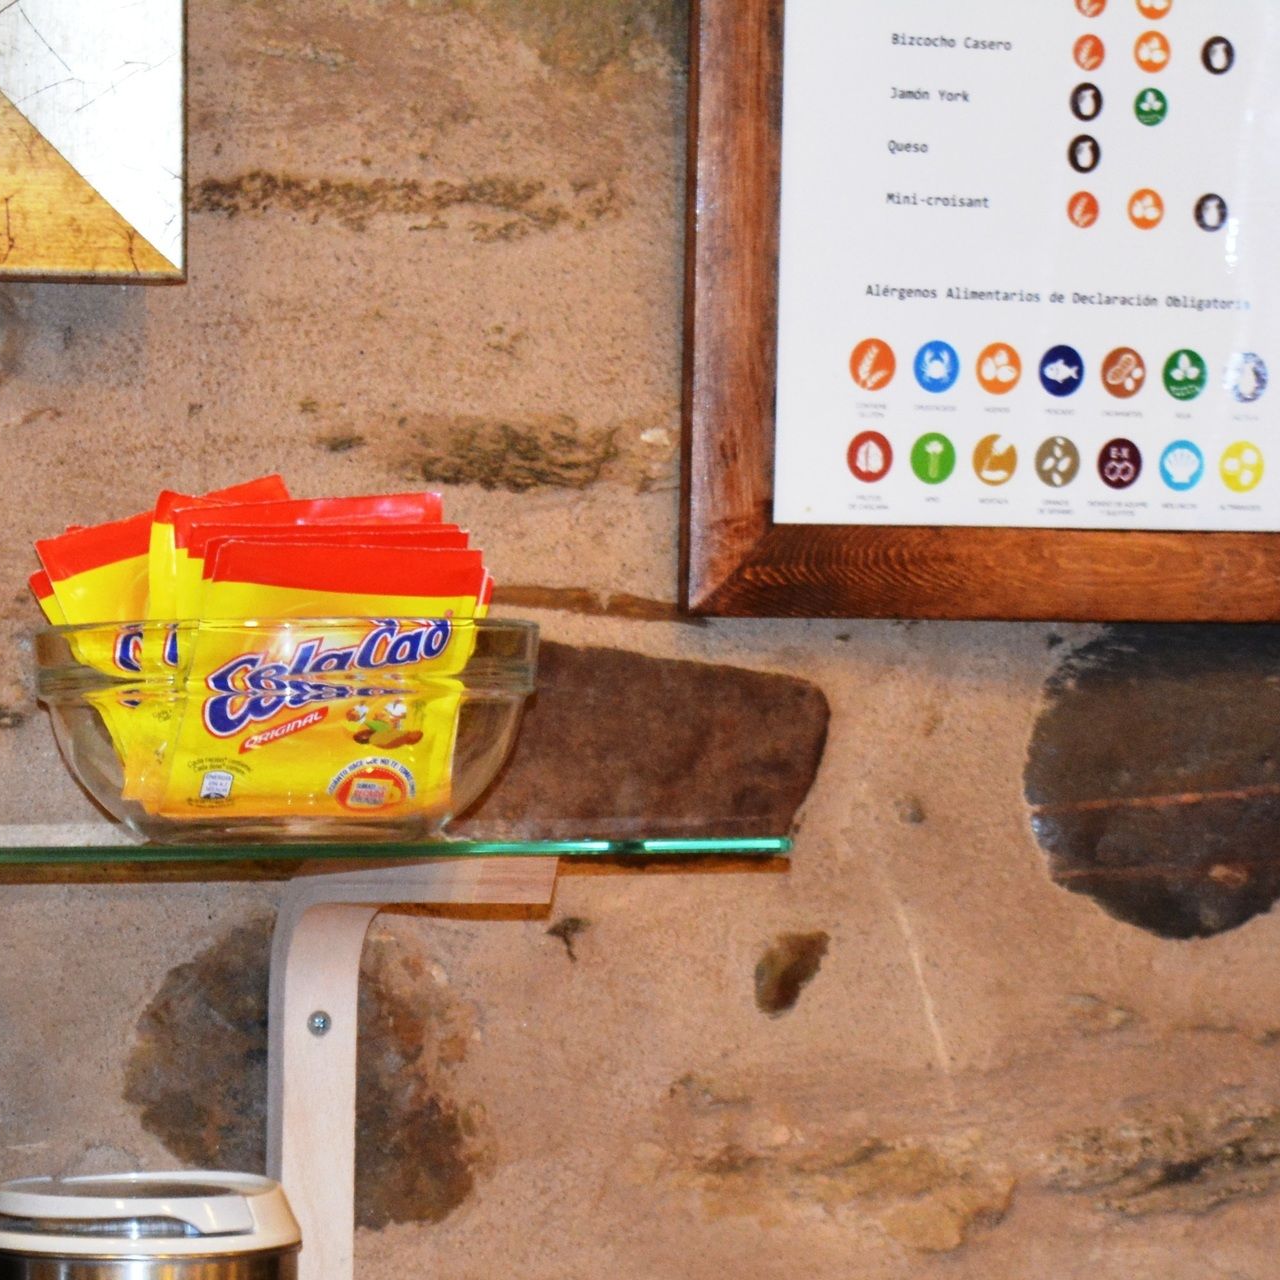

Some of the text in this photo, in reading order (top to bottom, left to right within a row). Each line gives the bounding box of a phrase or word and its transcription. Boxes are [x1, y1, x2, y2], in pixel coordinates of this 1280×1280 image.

[891, 32, 1012, 51] Bizcocho Casero
[890, 86, 970, 102] Jamón York
[887, 139, 928, 154] Queso
[886, 191, 989, 208] Mini-croisant
[866, 284, 938, 300] Alérgenos
[946, 287, 1041, 304] Alimentarios
[1049, 291, 1065, 304] de
[1072, 291, 1158, 308] Declaración
[244, 710, 323, 750] ORIGINAL
